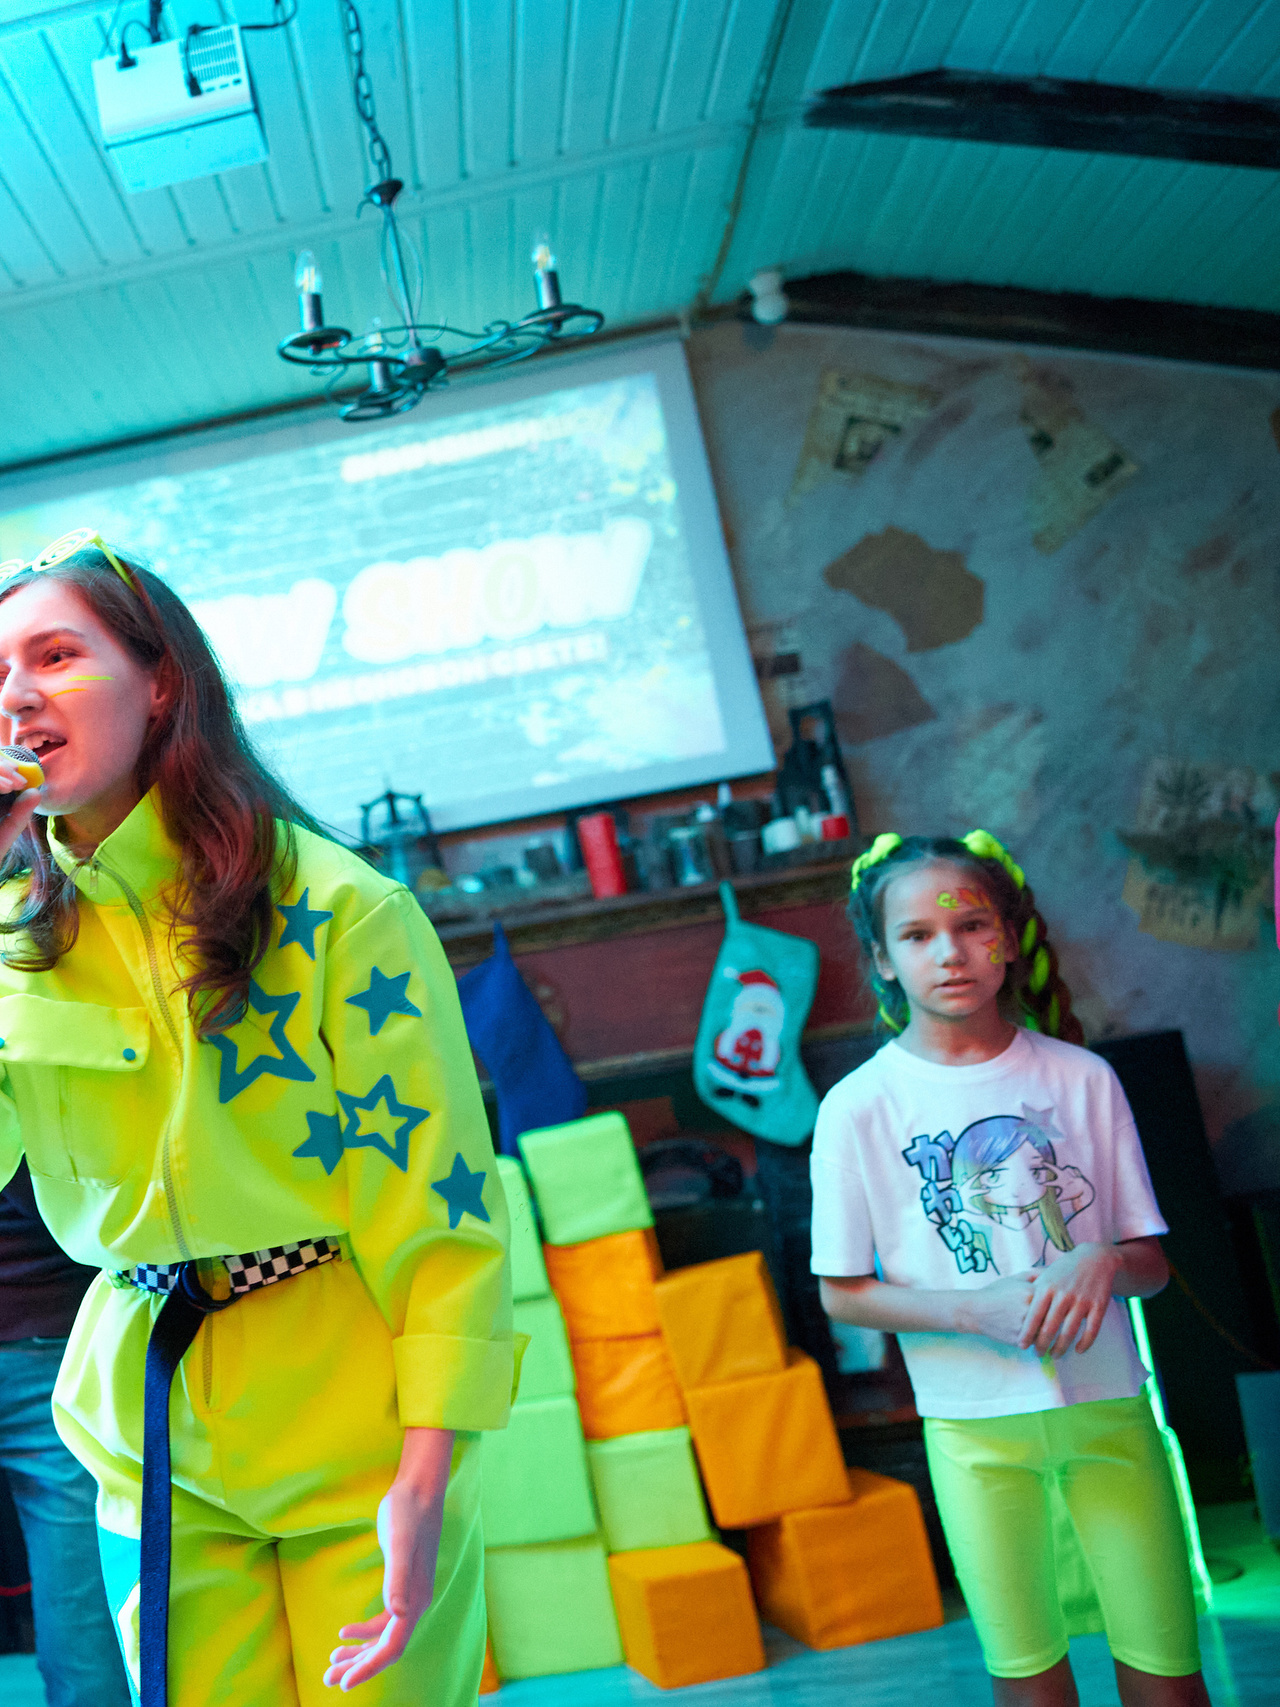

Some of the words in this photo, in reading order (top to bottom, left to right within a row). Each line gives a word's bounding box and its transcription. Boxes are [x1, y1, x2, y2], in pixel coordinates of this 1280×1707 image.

[344, 517, 653, 663] SHOW
[902, 1130, 987, 1273] かわいい
